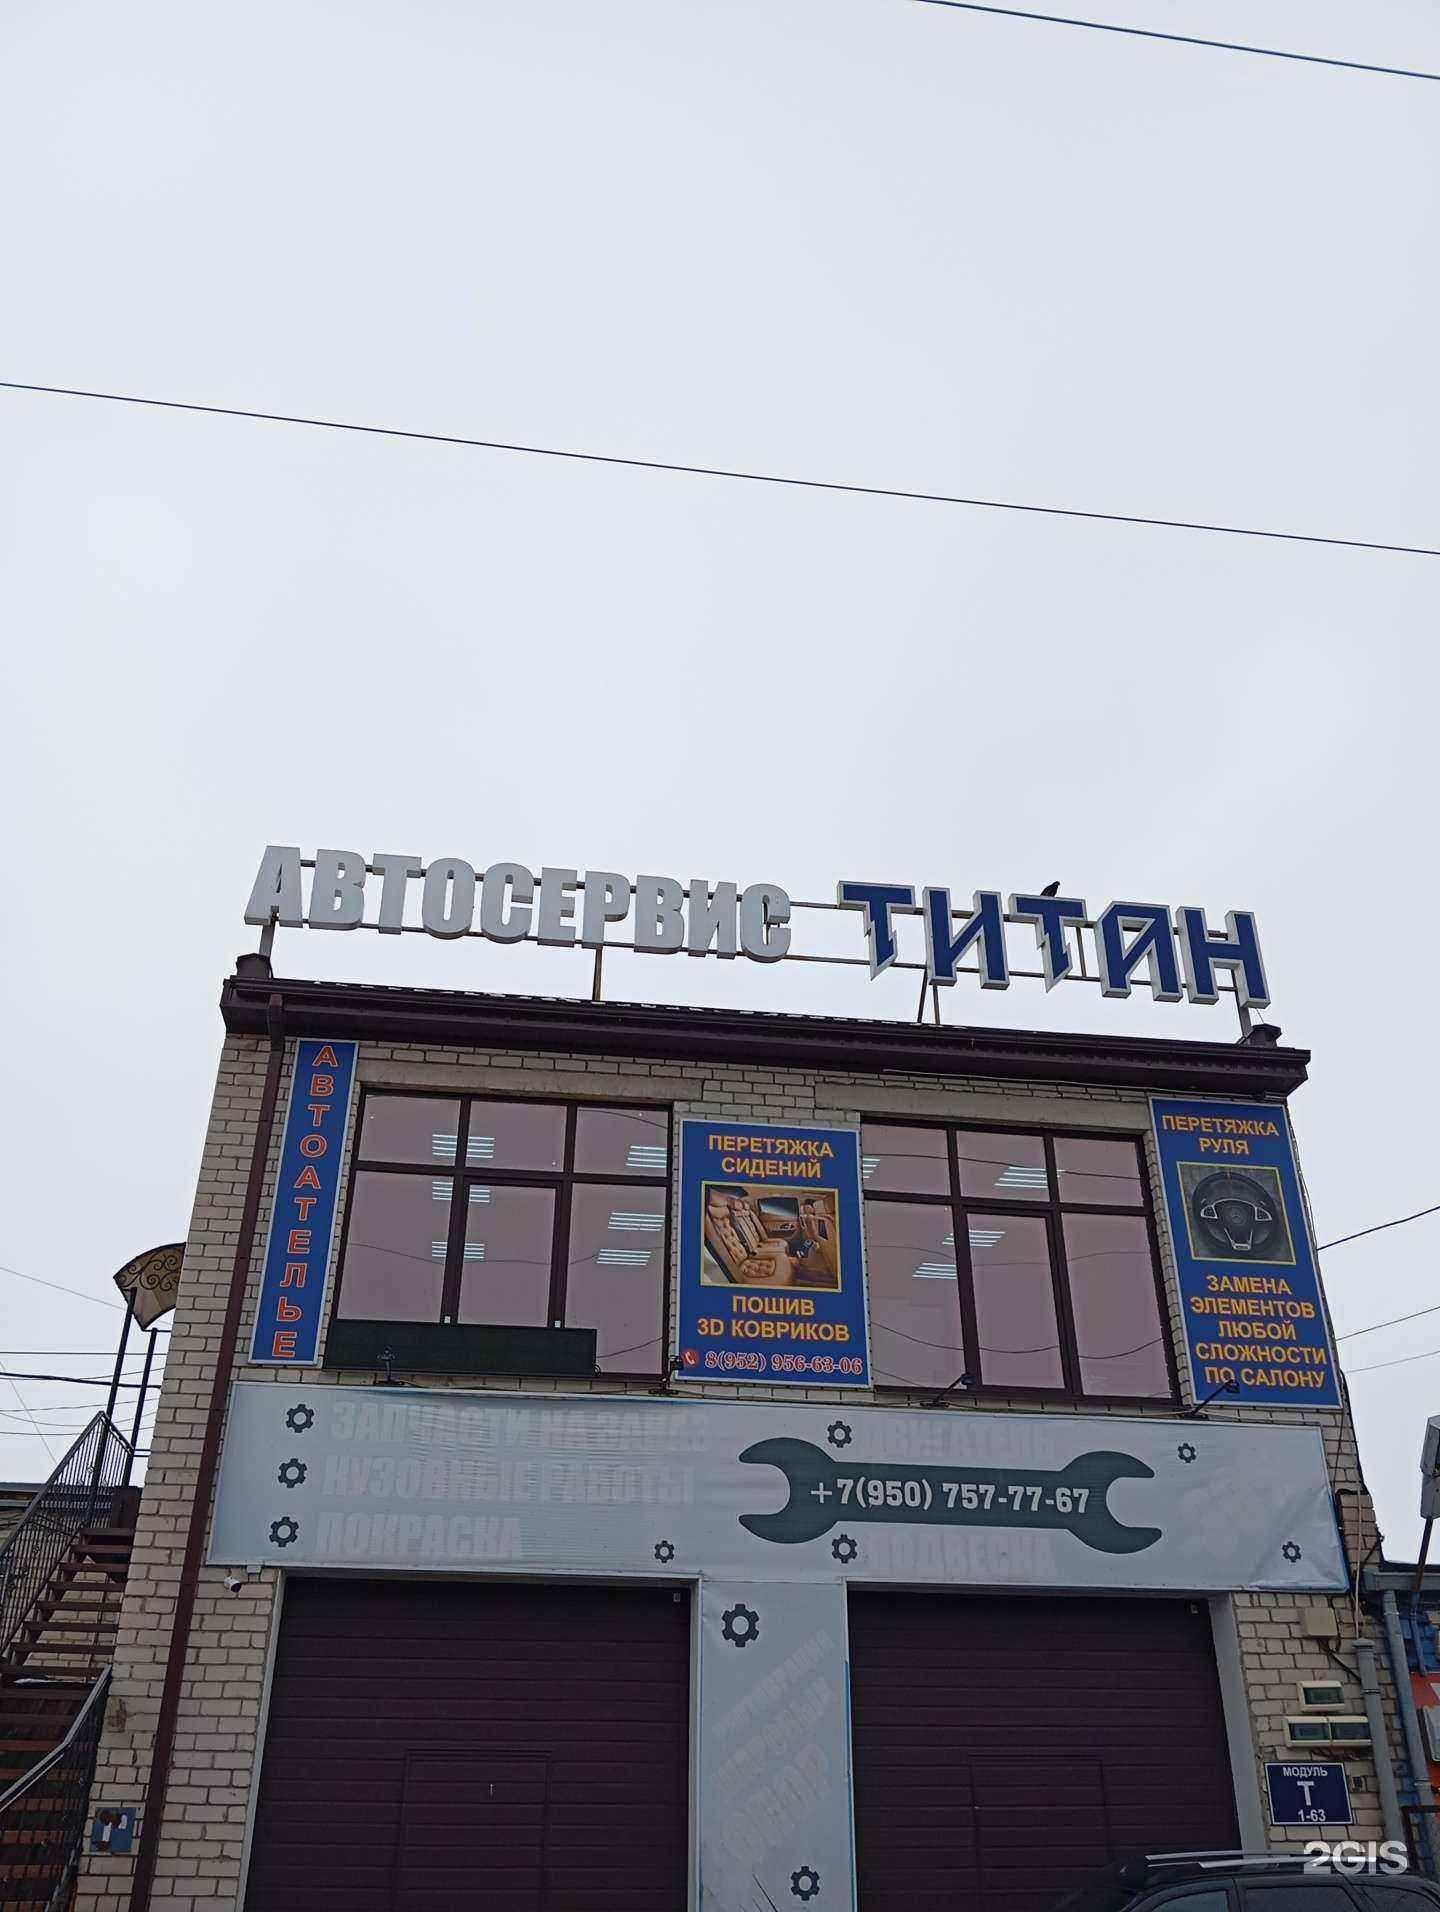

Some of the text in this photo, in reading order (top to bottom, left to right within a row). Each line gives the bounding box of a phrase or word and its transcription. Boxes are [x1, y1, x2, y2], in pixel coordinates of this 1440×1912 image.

[244, 845, 1271, 1009] АВТОСЕРВИС ТИТАН
[1162, 1114, 1279, 1137] ПЕРЕТЯЖКА
[708, 1135, 834, 1158] ПЕРЕТЯЖКА
[1199, 1137, 1249, 1155] РУЛЯ
[721, 1157, 822, 1178] СИДЕНИЙ
[272, 1045, 338, 1357] АВТОАТЕЛЬЕ
[1207, 1275, 1292, 1295] ЗАМЕНА
[732, 1295, 815, 1316] ПОШИВ
[1190, 1297, 1315, 1319] ЭЛЕМЕНТОВ
[697, 1318, 850, 1341] 3D КОВРИКОВ
[1219, 1320, 1296, 1341] ЛЮБОЙ
[705, 1351, 862, 1374] 8(952) 956-63-06
[1195, 1342, 1327, 1366] СЛОЖНОСТИ
[1205, 1367, 1325, 1389] ПО САЛОНУ
[810, 1478, 1090, 1514] +7(950) 757-77-67
[315, 1512, 523, 1559] ПОКРАСКА
[1282, 1766, 1328, 1777] МОДУЛЬ
[1297, 1781, 1314, 1805] Т
[1298, 1809, 1326, 1822] 1-63
